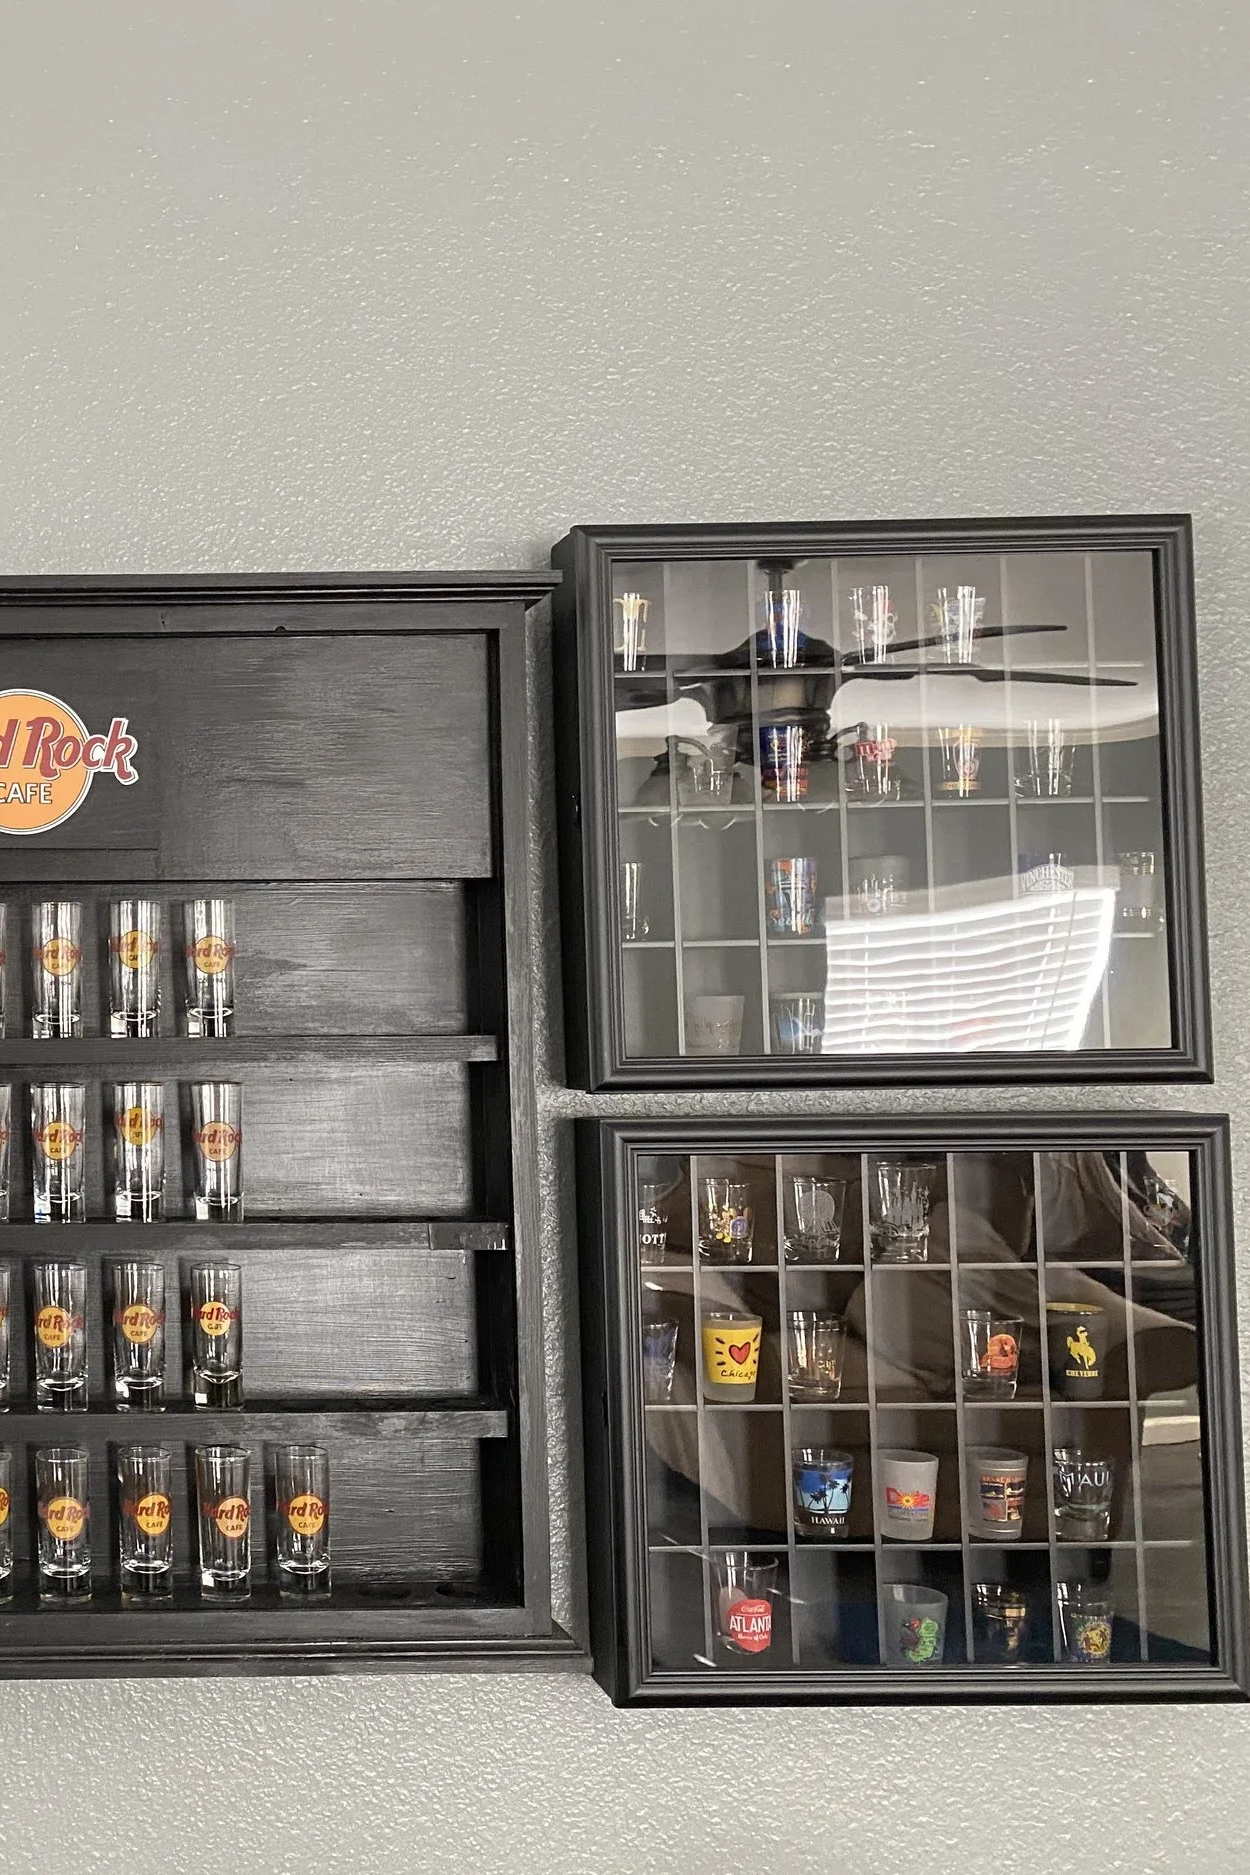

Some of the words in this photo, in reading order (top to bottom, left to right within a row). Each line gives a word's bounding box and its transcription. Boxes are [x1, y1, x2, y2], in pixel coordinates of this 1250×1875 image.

[22, 716, 139, 786] Rock
[1021, 864, 1074, 891] WINCHESTER
[770, 909, 815, 926] Seale
[1059, 1470, 1110, 1487] MAUI
[811, 1516, 845, 1525] HAWAII
